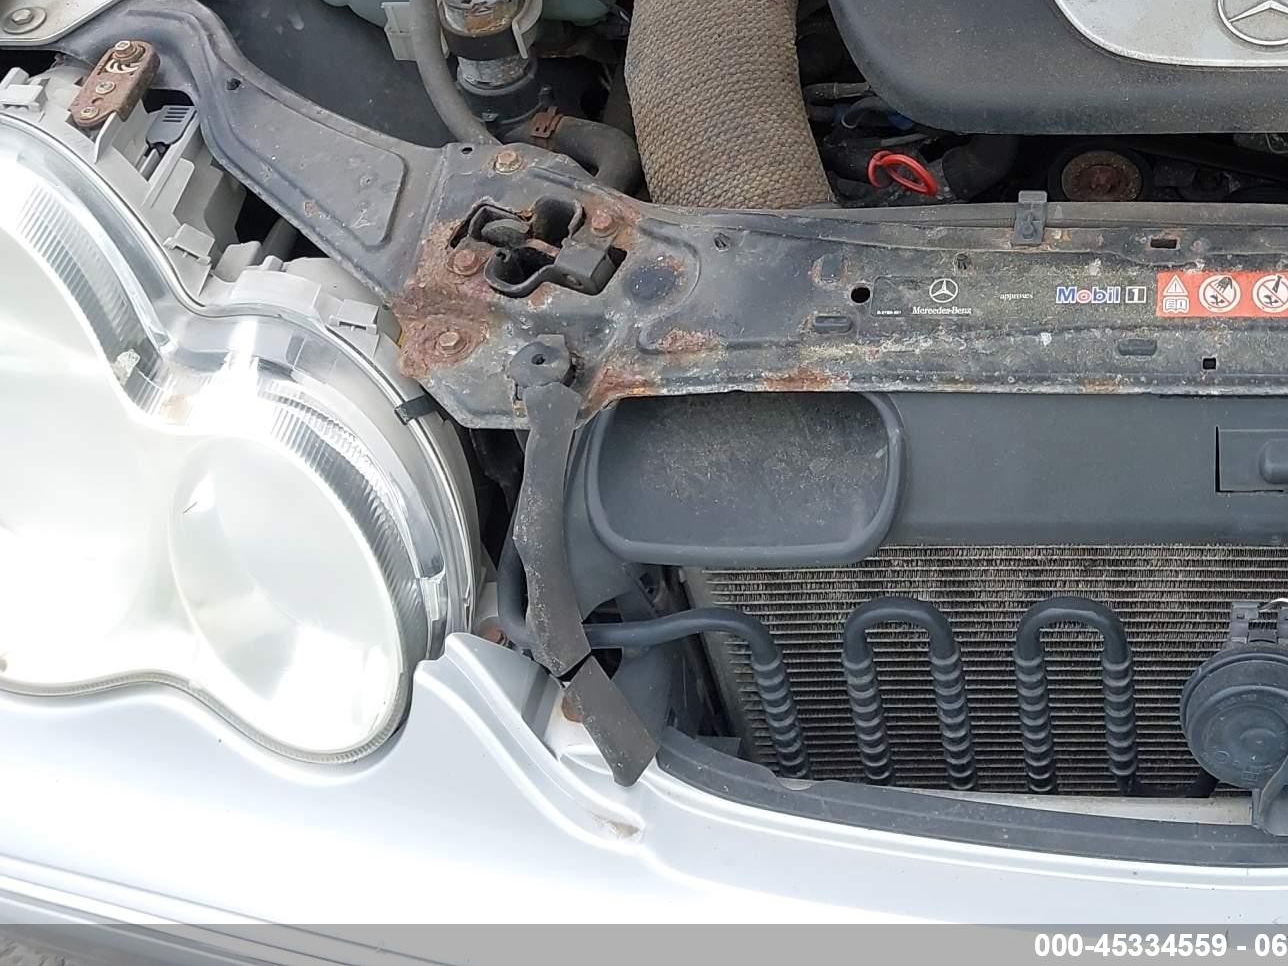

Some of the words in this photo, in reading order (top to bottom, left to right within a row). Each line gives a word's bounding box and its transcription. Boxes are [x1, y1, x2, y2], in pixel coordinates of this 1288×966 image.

[1055, 286, 1121, 304] Mobil
[1125, 286, 1147, 304] 1
[912, 306, 972, 315] Mercedes-Benz
